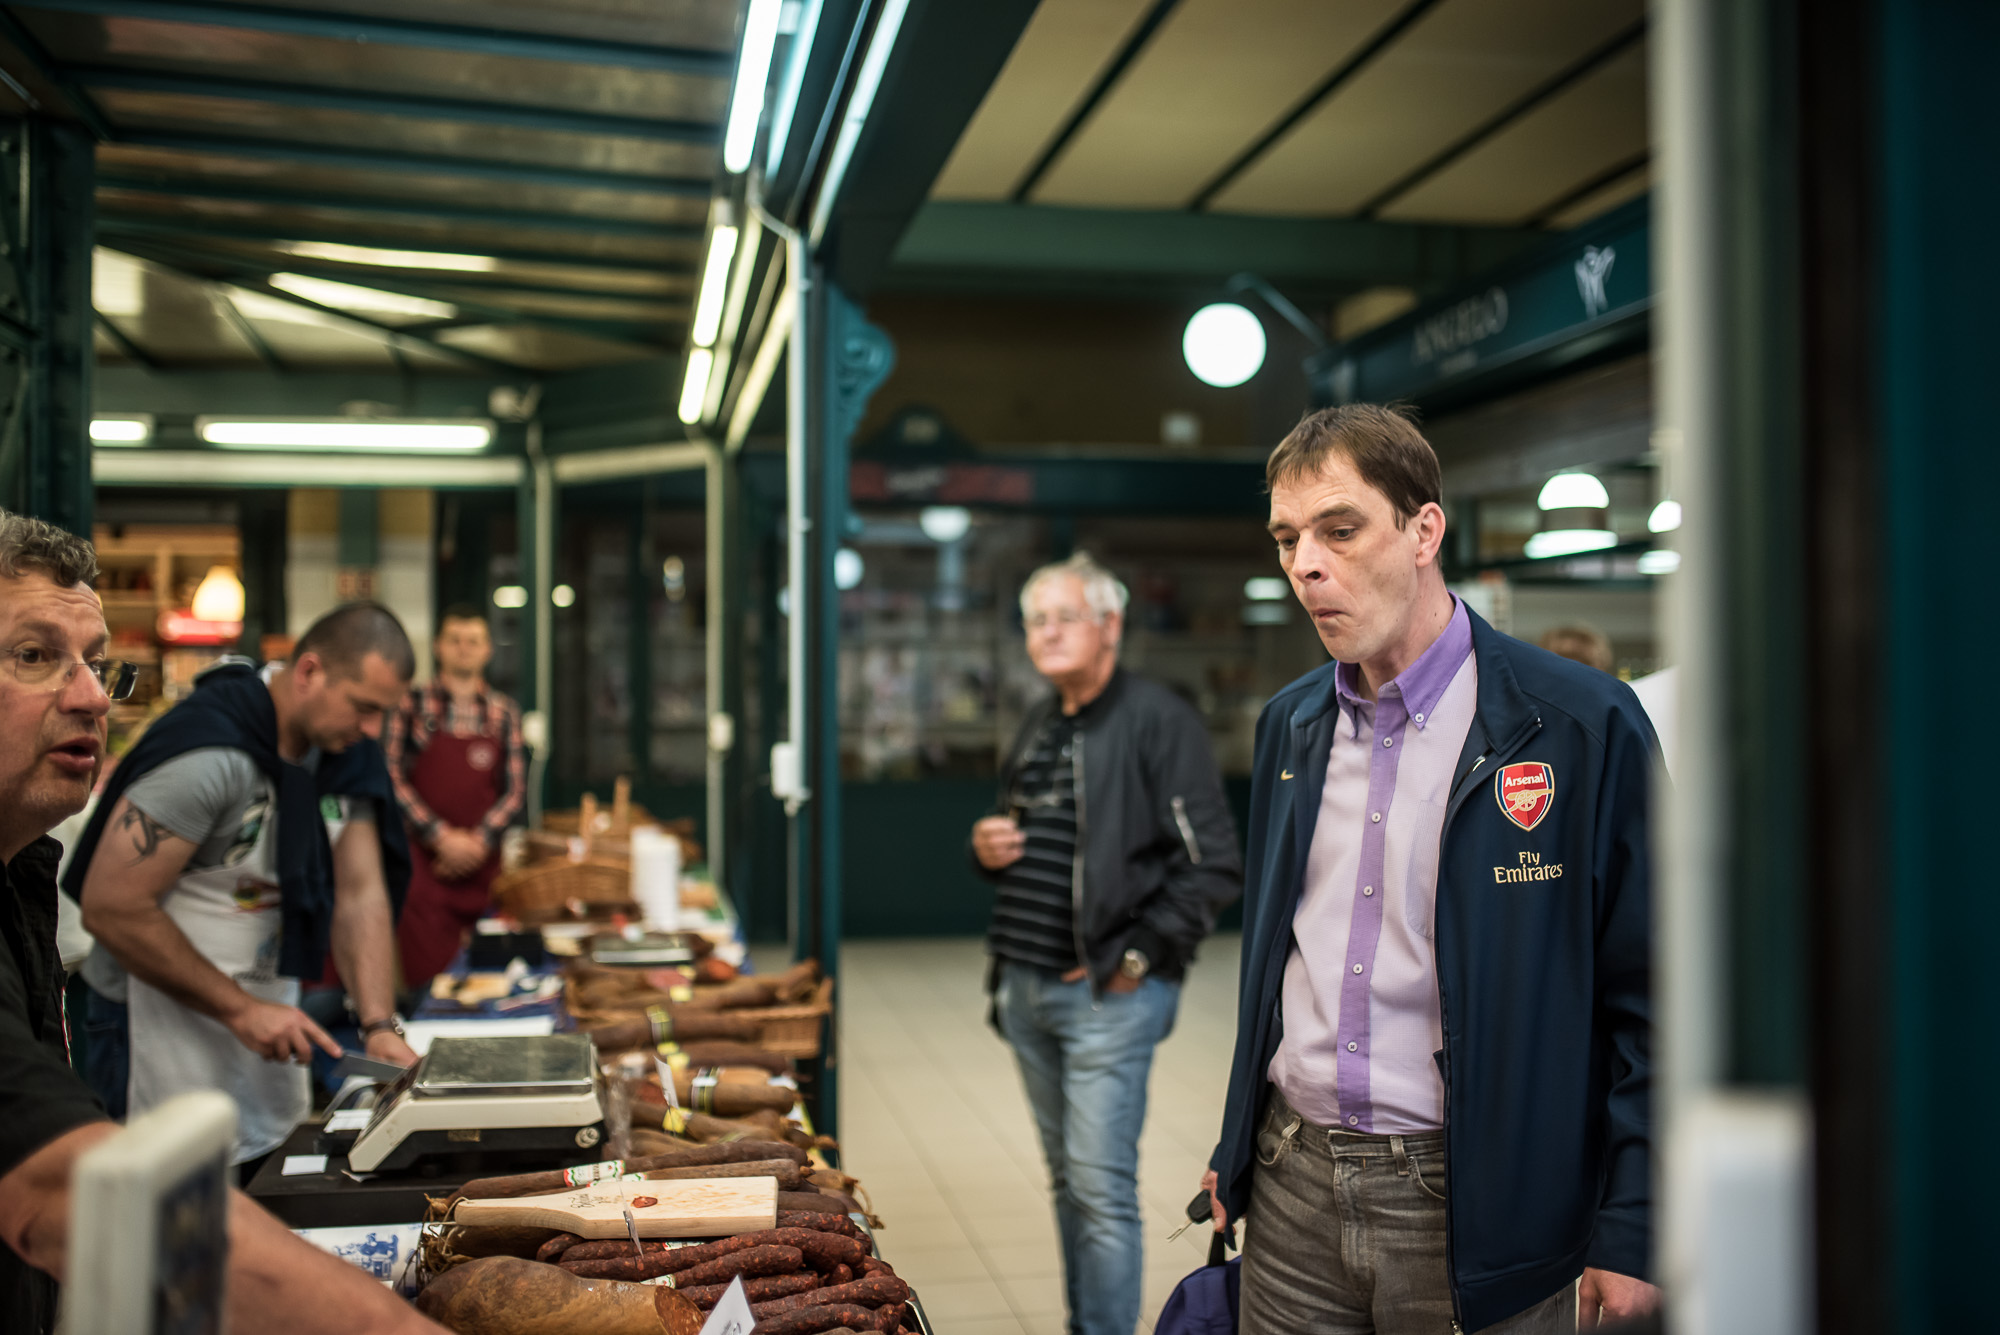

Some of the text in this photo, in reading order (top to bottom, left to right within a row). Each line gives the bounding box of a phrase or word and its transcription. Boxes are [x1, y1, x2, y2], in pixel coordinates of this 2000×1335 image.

[1504, 773, 1545, 788] Arsenal
[1518, 851, 1540, 865] Fly
[1493, 863, 1563, 884] Emirates
